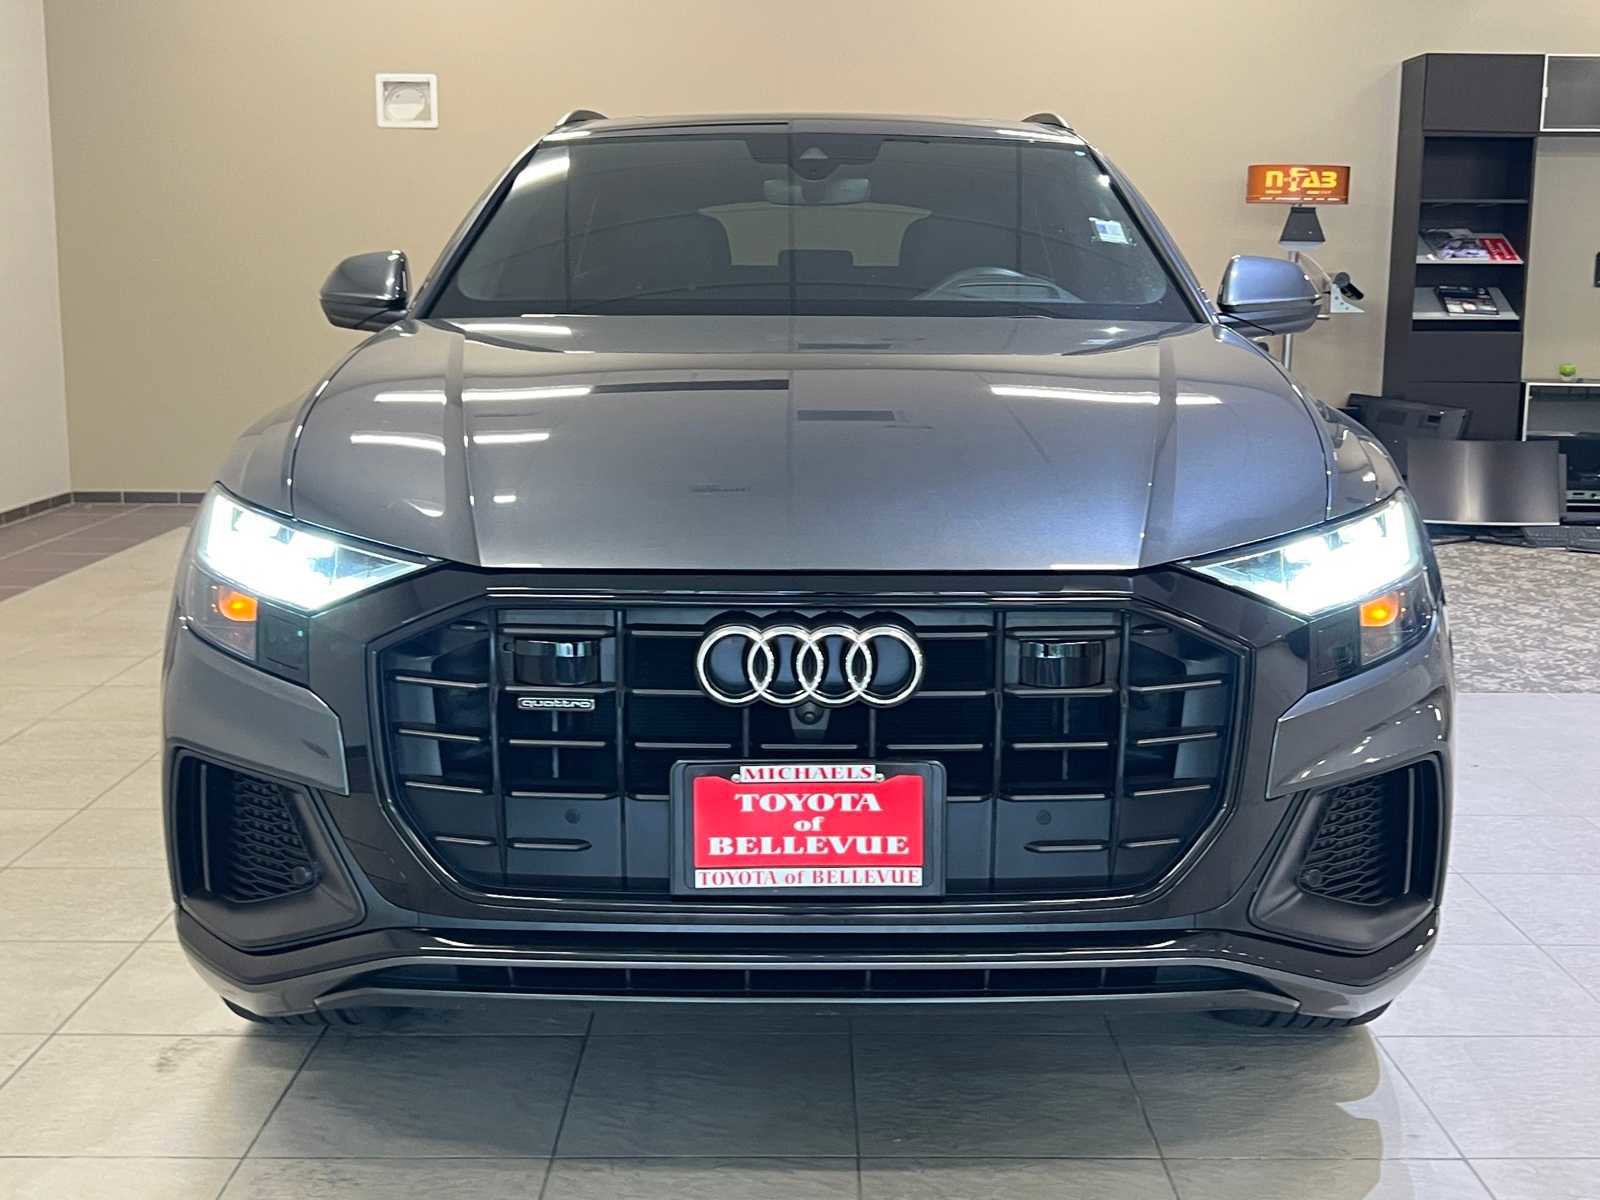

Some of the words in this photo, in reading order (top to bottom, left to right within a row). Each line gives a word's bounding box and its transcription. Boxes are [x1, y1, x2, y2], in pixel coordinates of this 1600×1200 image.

[521, 699, 592, 708] quattro
[742, 766, 874, 781] MICHAELS
[734, 793, 883, 812] TOYOTA
[793, 816, 825, 832] of
[707, 836, 910, 856] BELLEVUE
[699, 871, 778, 886] TOYOTA
[784, 871, 804, 885] of
[811, 868, 920, 884] BELLEVUE
